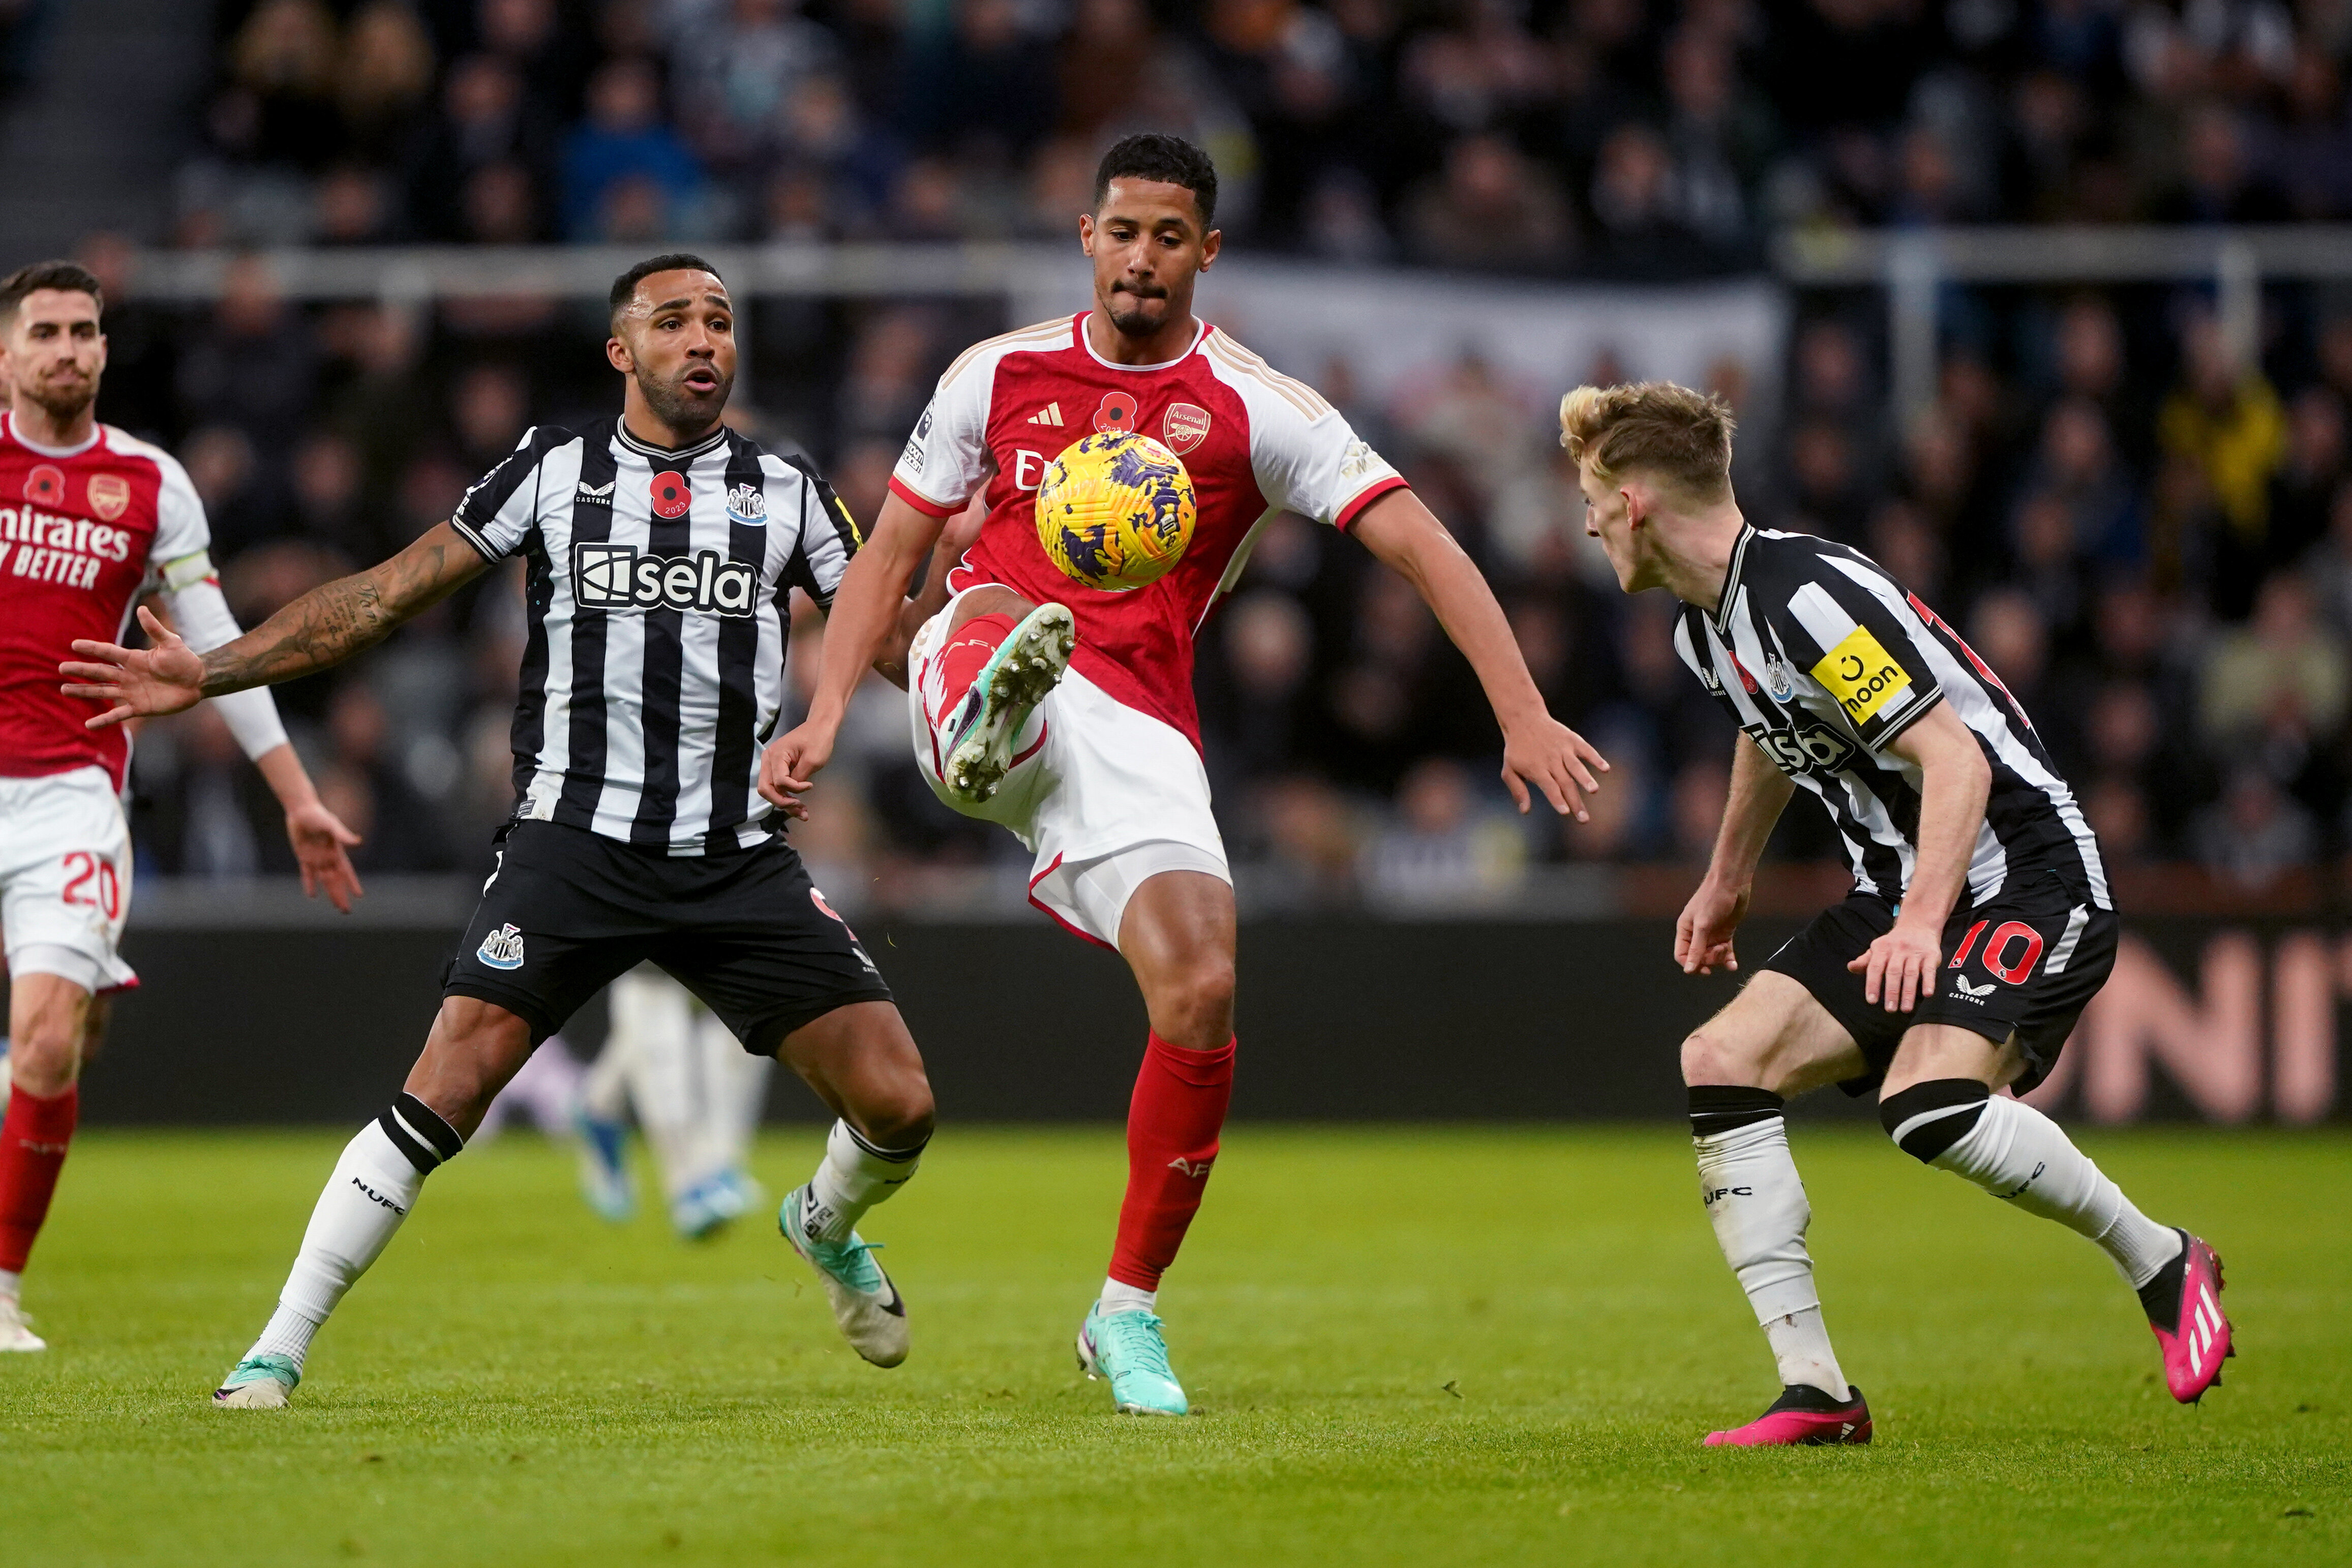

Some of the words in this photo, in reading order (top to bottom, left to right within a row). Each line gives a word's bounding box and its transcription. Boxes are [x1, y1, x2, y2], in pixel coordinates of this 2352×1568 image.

[1172, 411, 1204, 425] Arsenal
[1015, 448, 1052, 491] E
[576, 496, 611, 505] CASTORE
[665, 501, 685, 514] 2023
[12, 545, 101, 590] BETTER
[635, 557, 751, 609] sela
[1846, 666, 1898, 713] noon
[63, 850, 119, 921] 20
[1948, 919, 2044, 985] 10
[1948, 992, 1985, 1006] CASTORE
[352, 1177, 405, 1216] NUFC
[1703, 1187, 1753, 1209] UFC
